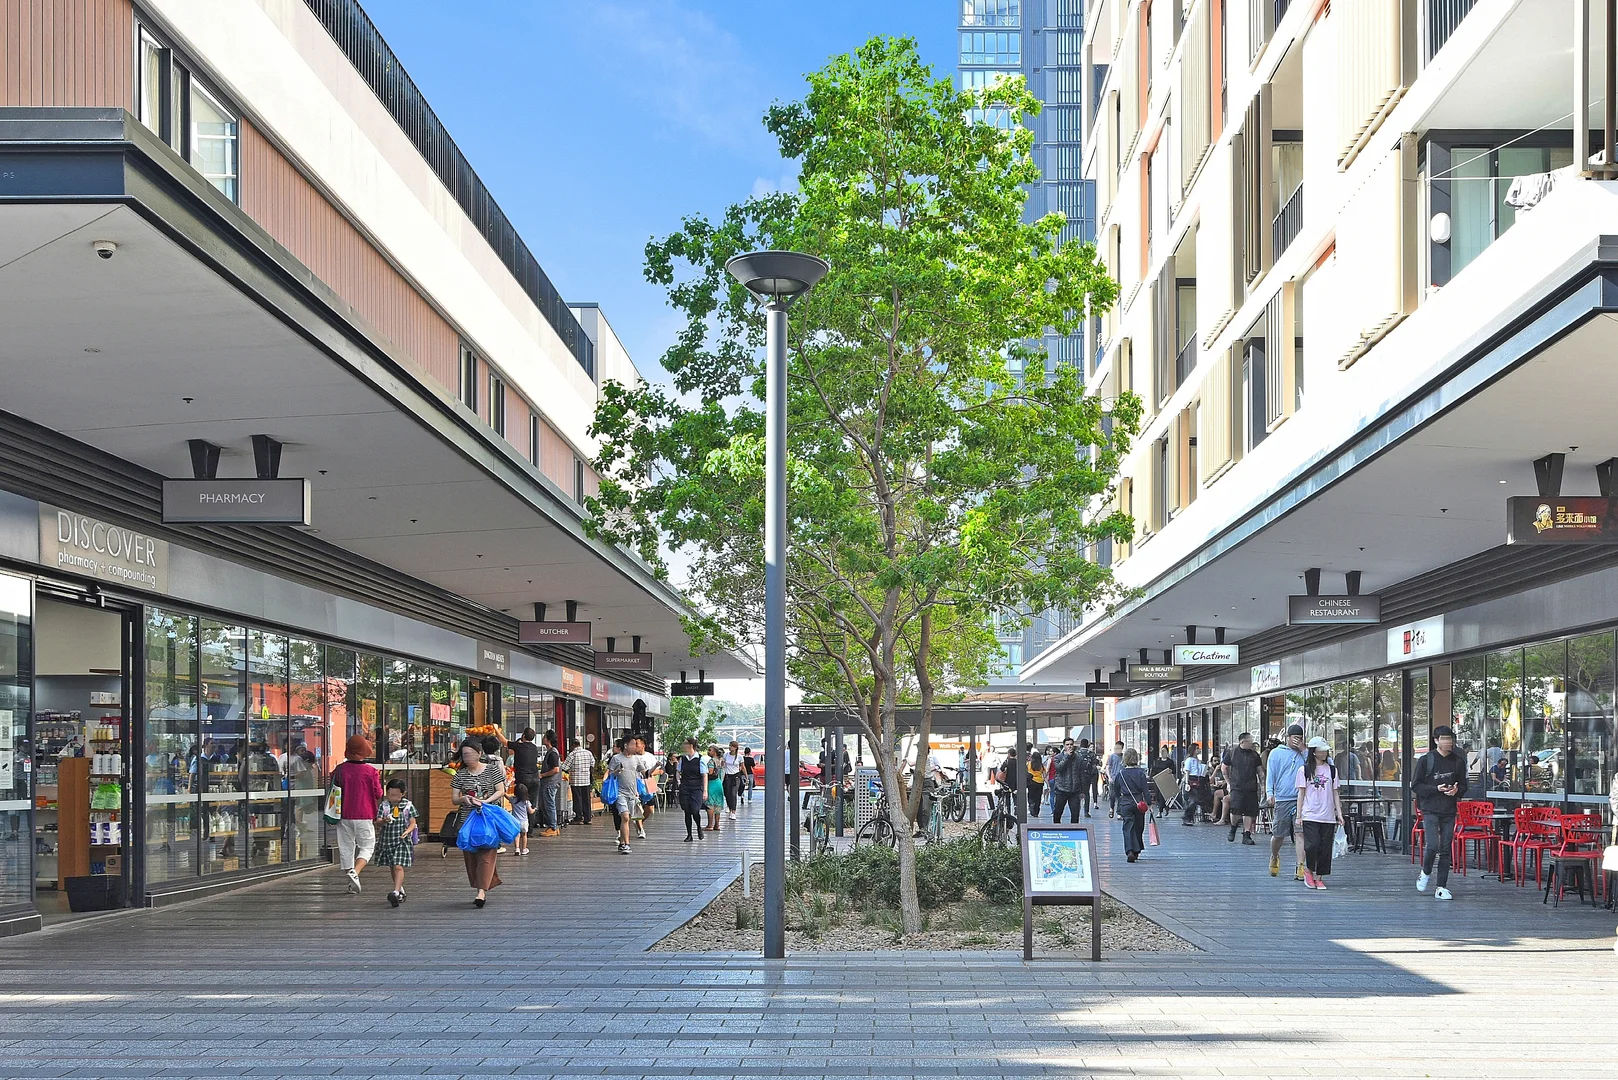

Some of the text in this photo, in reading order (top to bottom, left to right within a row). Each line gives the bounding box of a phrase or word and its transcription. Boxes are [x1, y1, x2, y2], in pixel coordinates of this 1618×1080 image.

[199, 493, 265, 503] PHARMACY
[57, 511, 156, 567] DISCOVER
[58, 547, 98, 574] pharmacy
[108, 564, 156, 588] compounding
[1318, 599, 1351, 607] CHINESE
[1310, 608, 1360, 617] RESTAURANT
[1191, 651, 1231, 661] Chatime
